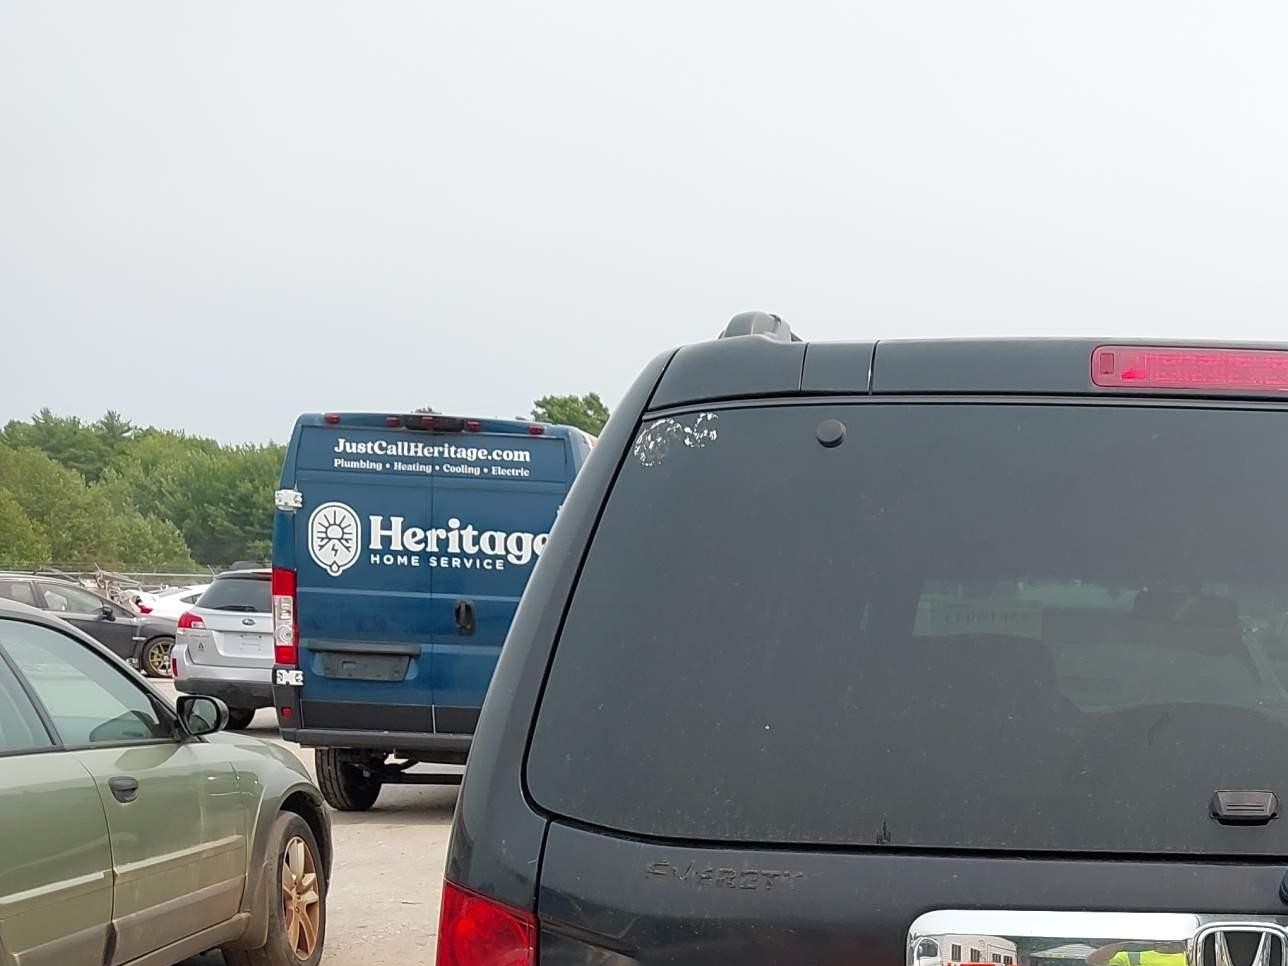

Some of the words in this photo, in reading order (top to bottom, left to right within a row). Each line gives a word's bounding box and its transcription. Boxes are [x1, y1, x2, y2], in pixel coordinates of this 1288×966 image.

[333, 437, 531, 463] JustCallHeritage.com
[333, 458, 383, 472] Plumbing
[393, 461, 433, 474] Heating
[442, 463, 481, 476] Cooling
[491, 466, 530, 477] Electric
[370, 554, 420, 567] HOME
[429, 556, 505, 571] SERVICE
